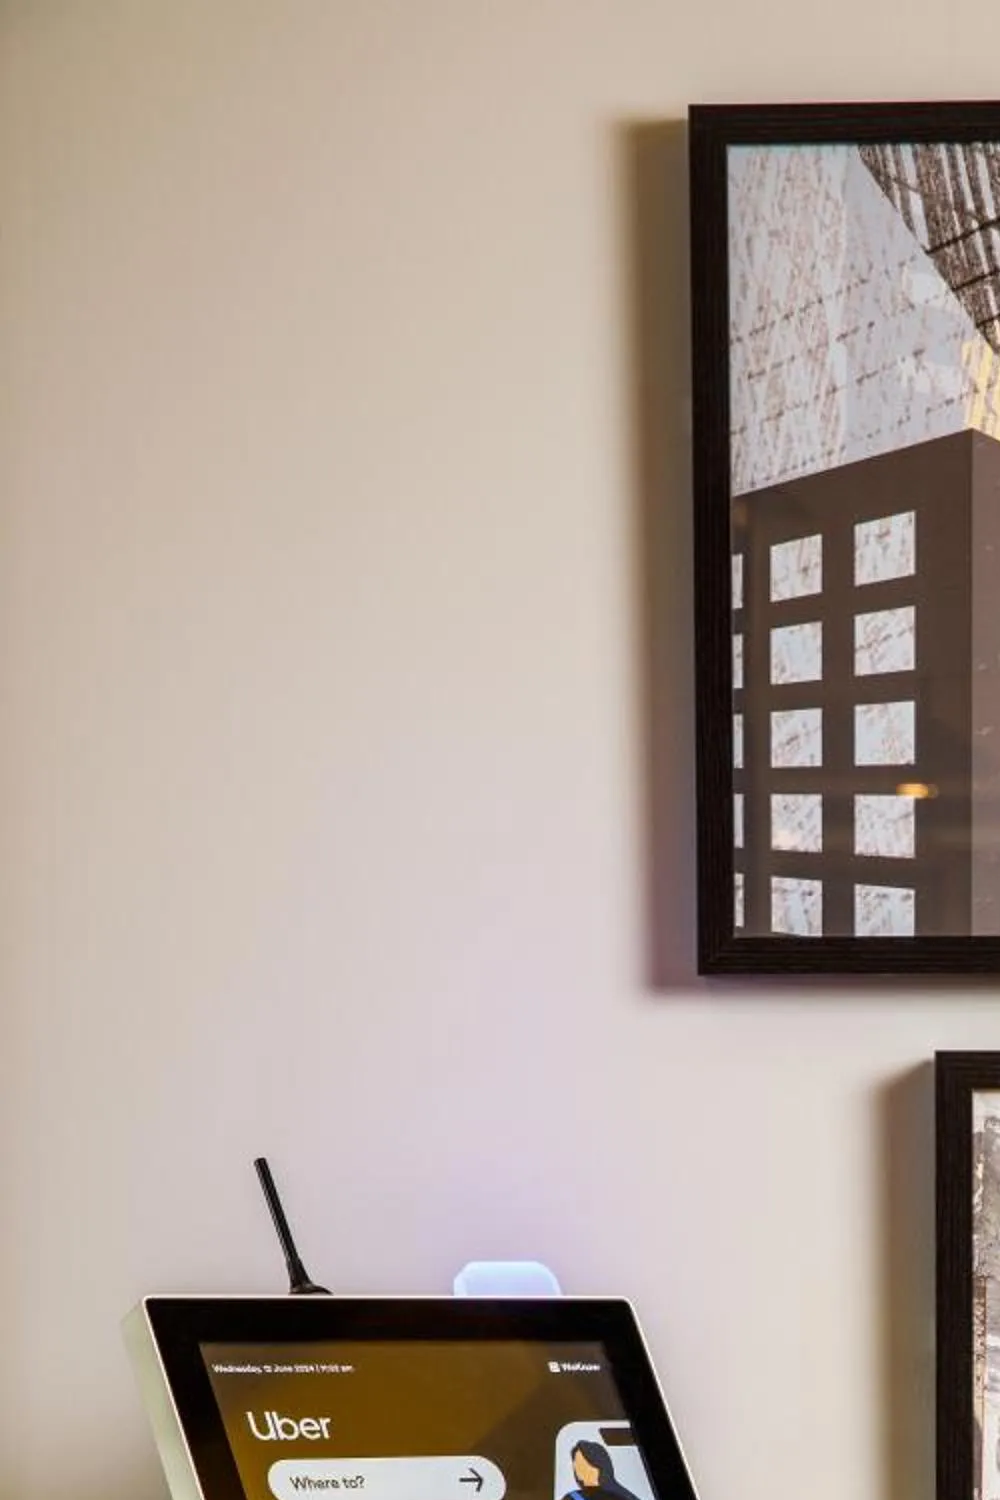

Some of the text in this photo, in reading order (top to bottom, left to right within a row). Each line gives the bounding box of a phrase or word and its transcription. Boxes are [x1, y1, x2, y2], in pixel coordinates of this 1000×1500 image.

[246, 1411, 331, 1441] Uber
[289, 1475, 365, 1490] Where to?
